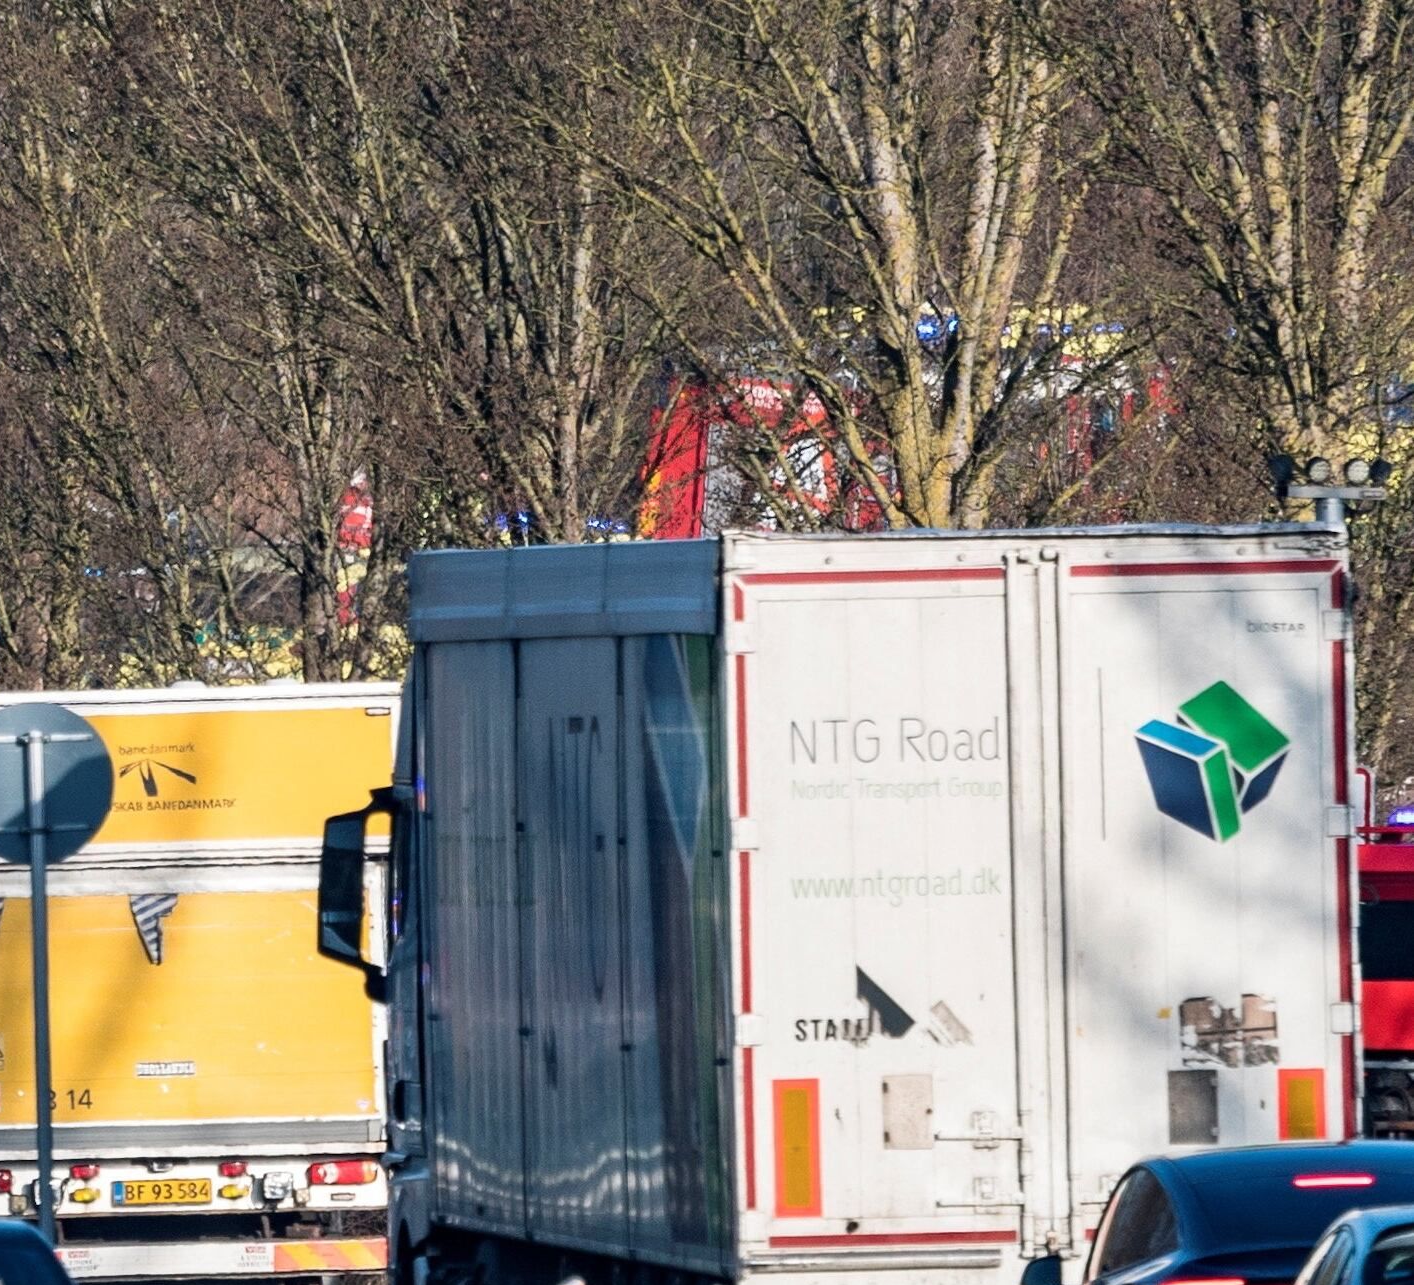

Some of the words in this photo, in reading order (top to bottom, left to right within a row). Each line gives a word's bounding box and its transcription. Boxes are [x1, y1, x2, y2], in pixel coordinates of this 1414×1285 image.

[790, 718, 881, 765] NTG
[899, 716, 1002, 763] Road
[791, 779, 849, 800] Nordic
[855, 777, 942, 804] Transport
[947, 776, 1004, 801] Group
[112, 801, 143, 813] SKAB
[147, 798, 236, 812] BANEDANMARK
[790, 867, 1003, 908] www.ntgroad.dk
[67, 1089, 93, 1110] 14
[125, 1184, 146, 1201] BF
[151, 1183, 172, 1200] 93
[178, 1182, 210, 1199] 584
